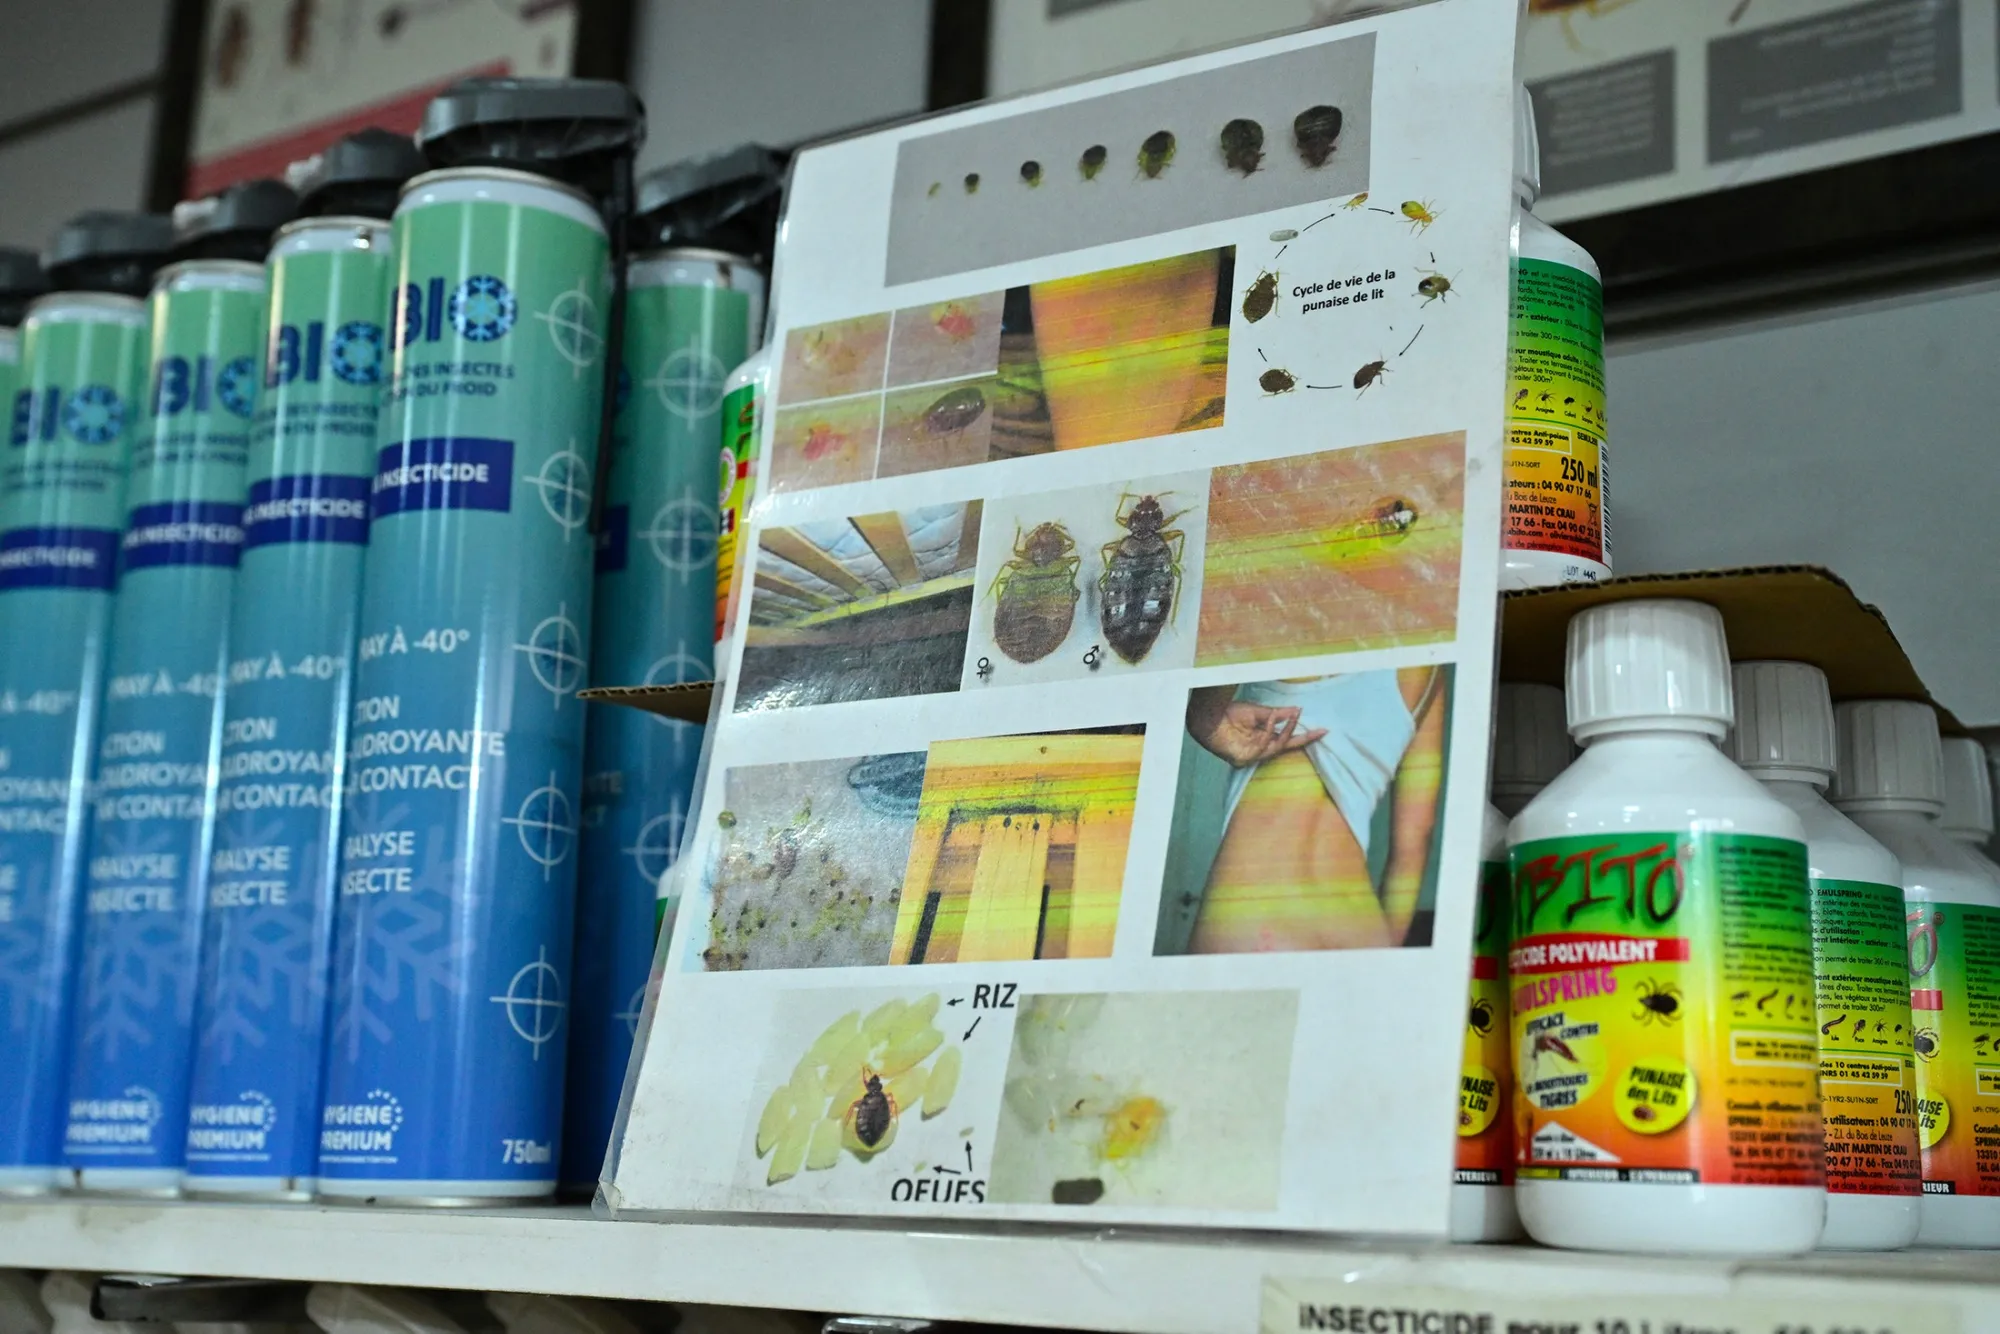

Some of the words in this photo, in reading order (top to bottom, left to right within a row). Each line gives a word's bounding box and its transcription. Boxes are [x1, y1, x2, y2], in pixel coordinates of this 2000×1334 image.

[1292, 283, 1324, 298] Cycle
[1326, 279, 1342, 291] de
[1345, 275, 1363, 288] vie
[1365, 271, 1382, 284] de
[1384, 269, 1396, 280] la
[1302, 296, 1349, 315] punaise
[1353, 291, 1368, 303] de
[1371, 287, 1385, 300] lit
[390, 275, 518, 353] BIO
[1540, 331, 1552, 340] 300
[1533, 430, 1569, 441] Anti-poison
[378, 463, 489, 490] INSECTICIDE
[1561, 457, 1584, 484] 250
[1587, 465, 1598, 489] ml
[1514, 492, 1527, 501] Bois
[1529, 492, 1538, 501] de
[1541, 480, 1552, 490] 04
[1554, 482, 1564, 492] 90
[1565, 484, 1575, 494] 47
[1576, 486, 1584, 496] 17
[1584, 489, 1592, 499] 66
[253, 498, 365, 521] INSECTICIDE
[1509, 504, 1544, 516] MARTIN
[1544, 507, 1555, 516] DE
[1556, 508, 1576, 520] CRAU
[1511, 517, 1521, 527] 17
[1523, 517, 1535, 527] 66
[1541, 518, 1556, 529] Fax
[1557, 520, 1567, 531] 04
[1568, 523, 1578, 533] 90
[413, 628, 470, 655] -40°
[360, 764, 483, 793] CONTACT
[1817, 888, 1863, 899] EMULSPRING
[1820, 927, 1860, 936] d'utilisation
[1549, 939, 1658, 963] POLYVALENT
[1825, 956, 1847, 964] permet
[972, 982, 1018, 1009] RIZ
[1817, 1003, 1841, 1011] permet
[1820, 1060, 1833, 1068] des
[1871, 1063, 1900, 1072] Anti-poison
[1629, 1066, 1686, 1090] PUNAISE
[1861, 1071, 1871, 1079] 42
[1881, 1072, 1888, 1080] 59
[1468, 1093, 1489, 1112] Lits
[1894, 1089, 1911, 1114] 250
[1917, 1098, 1944, 1116] AISE
[1829, 1114, 1875, 1127] utilisateurs
[1880, 1117, 1889, 1127] 04
[1890, 1117, 1898, 1128] 90
[1920, 1115, 1937, 1130] its
[1846, 1129, 1854, 1140] du
[1855, 1129, 1868, 1140] Bois
[1869, 1130, 1878, 1140] de
[502, 1139, 551, 1164] 750ml
[1824, 1142, 1850, 1153] SAINT
[1851, 1143, 1883, 1154] MARTIN
[1883, 1144, 1893, 1155] DE
[1892, 1145, 1908, 1156] CRAU
[1976, 1150, 1998, 1160] 13310
[1826, 1156, 1838, 1167] 90
[1839, 1156, 1851, 1167] 47
[1854, 1157, 1863, 1167] 17
[1866, 1157, 1876, 1168] 66
[1881, 1158, 1893, 1169] Fax
[1922, 1182, 1949, 1194] RIEUR
[1299, 1305, 1493, 1334] INSECTICIDE
